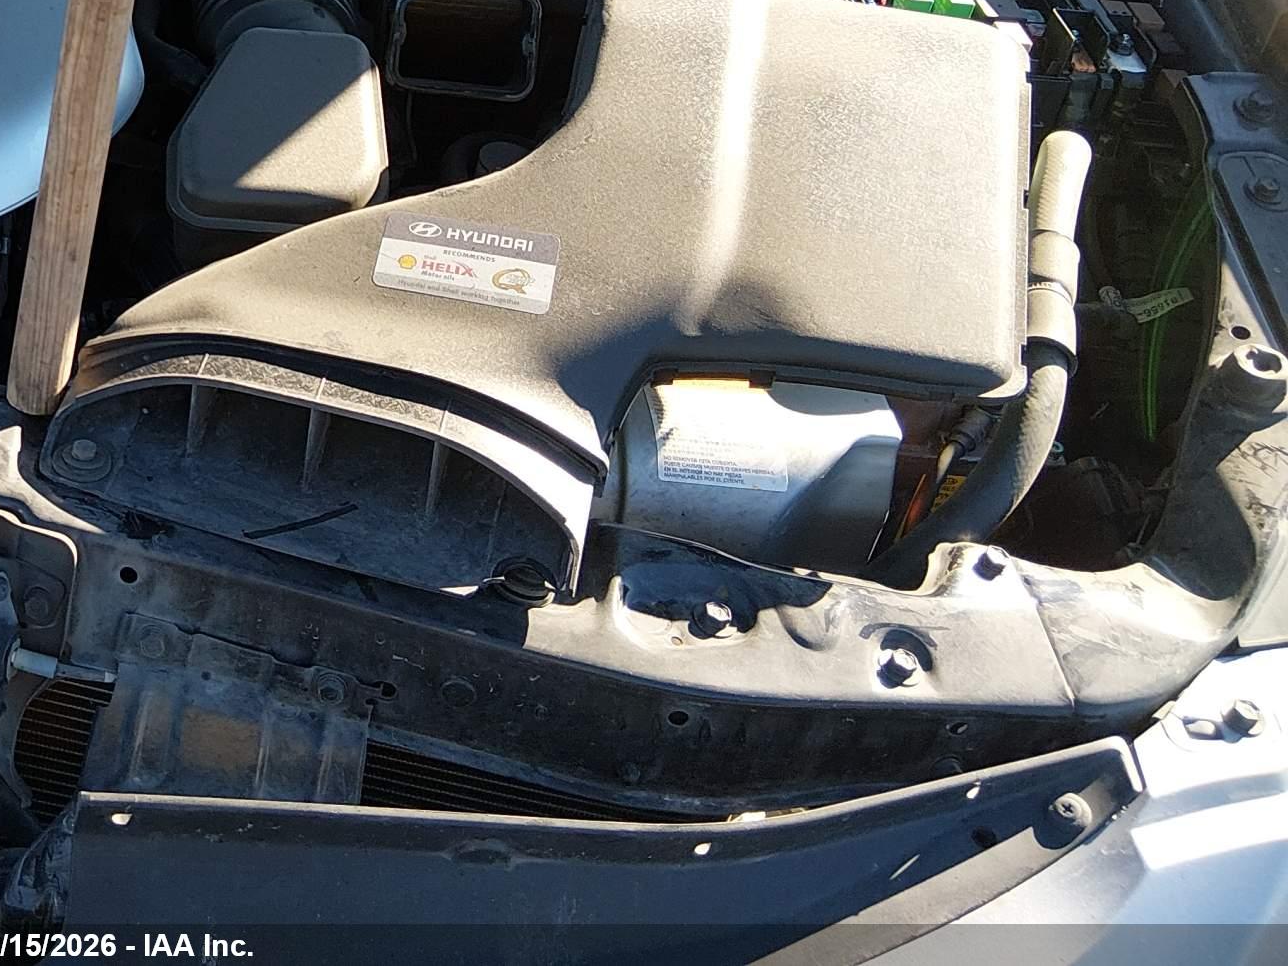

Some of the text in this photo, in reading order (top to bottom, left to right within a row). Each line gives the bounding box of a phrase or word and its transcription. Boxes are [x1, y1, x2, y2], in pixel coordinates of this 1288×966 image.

[445, 227, 534, 252] HYUNDAI
[442, 248, 496, 263] RECOMMENDS
[420, 259, 475, 277] HELIX
[420, 269, 442, 278] Motor
